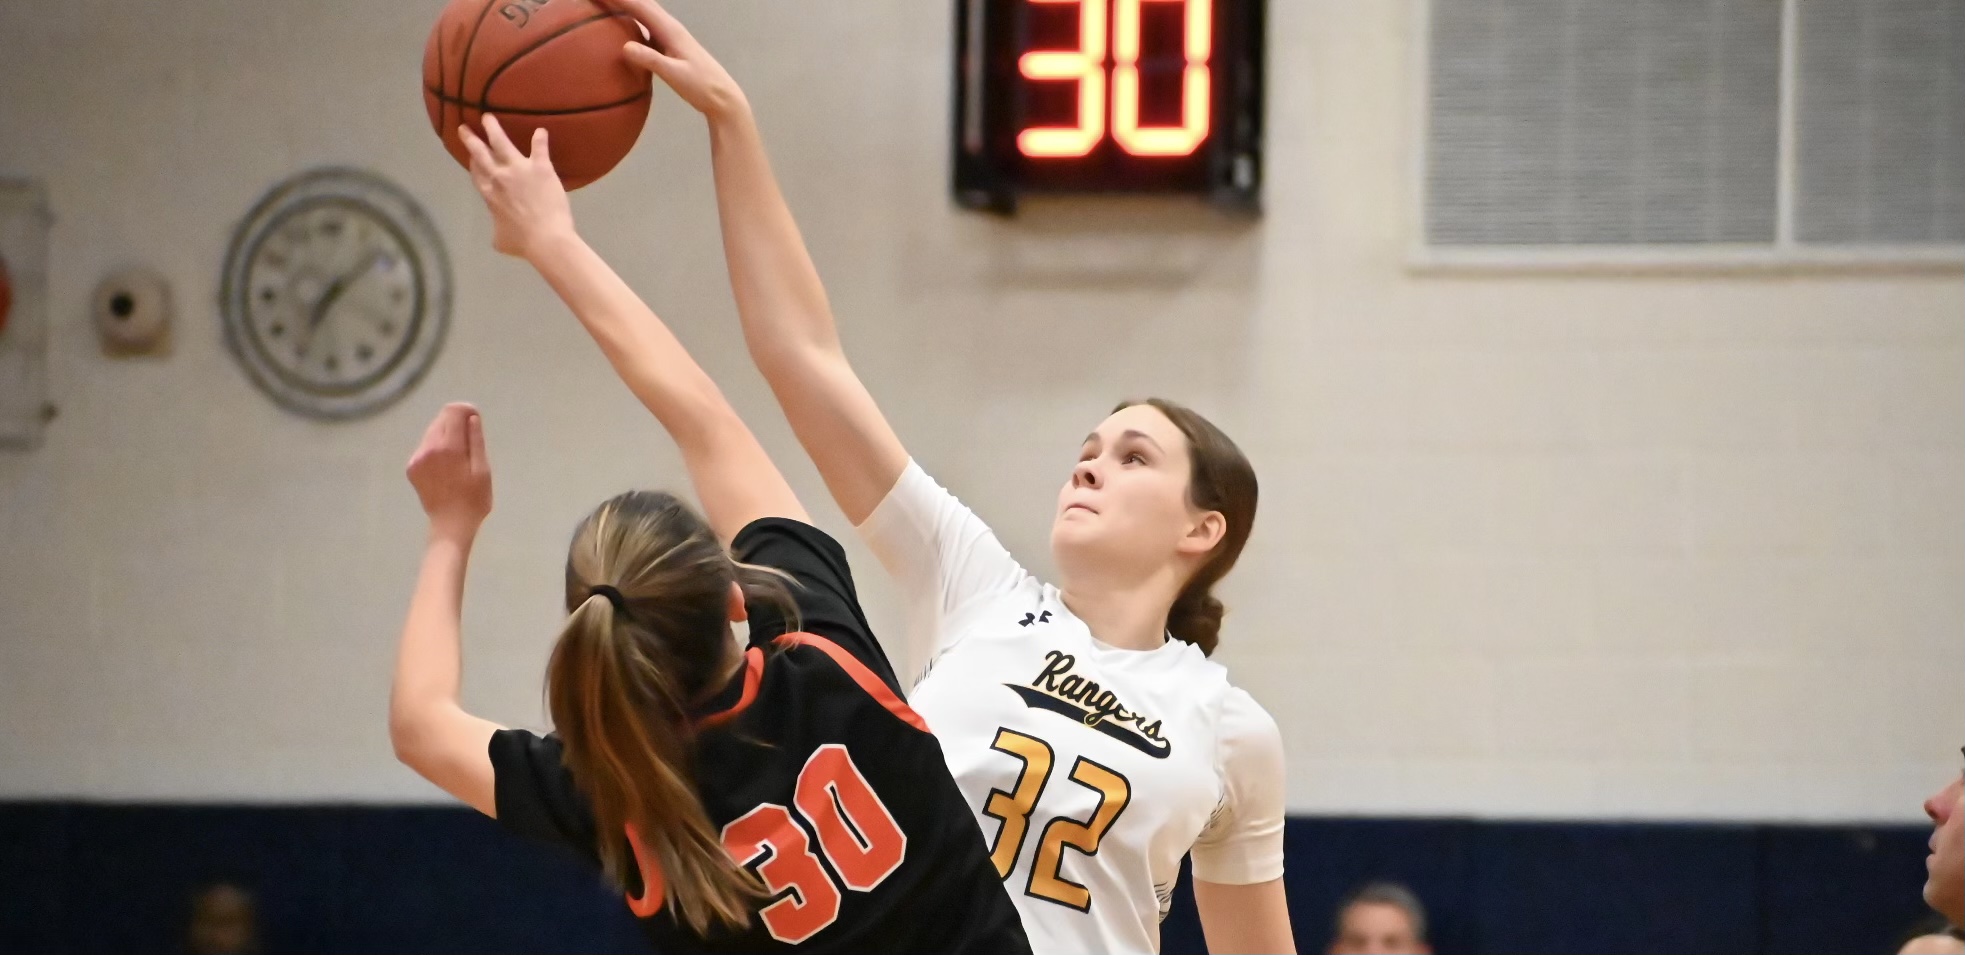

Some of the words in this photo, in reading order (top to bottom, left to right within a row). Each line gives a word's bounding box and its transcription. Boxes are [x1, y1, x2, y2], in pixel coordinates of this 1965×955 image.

[1016, 0, 1212, 158] 30
[1030, 650, 1168, 744] Rangers
[719, 743, 908, 945] 30
[982, 726, 1132, 914] 32
